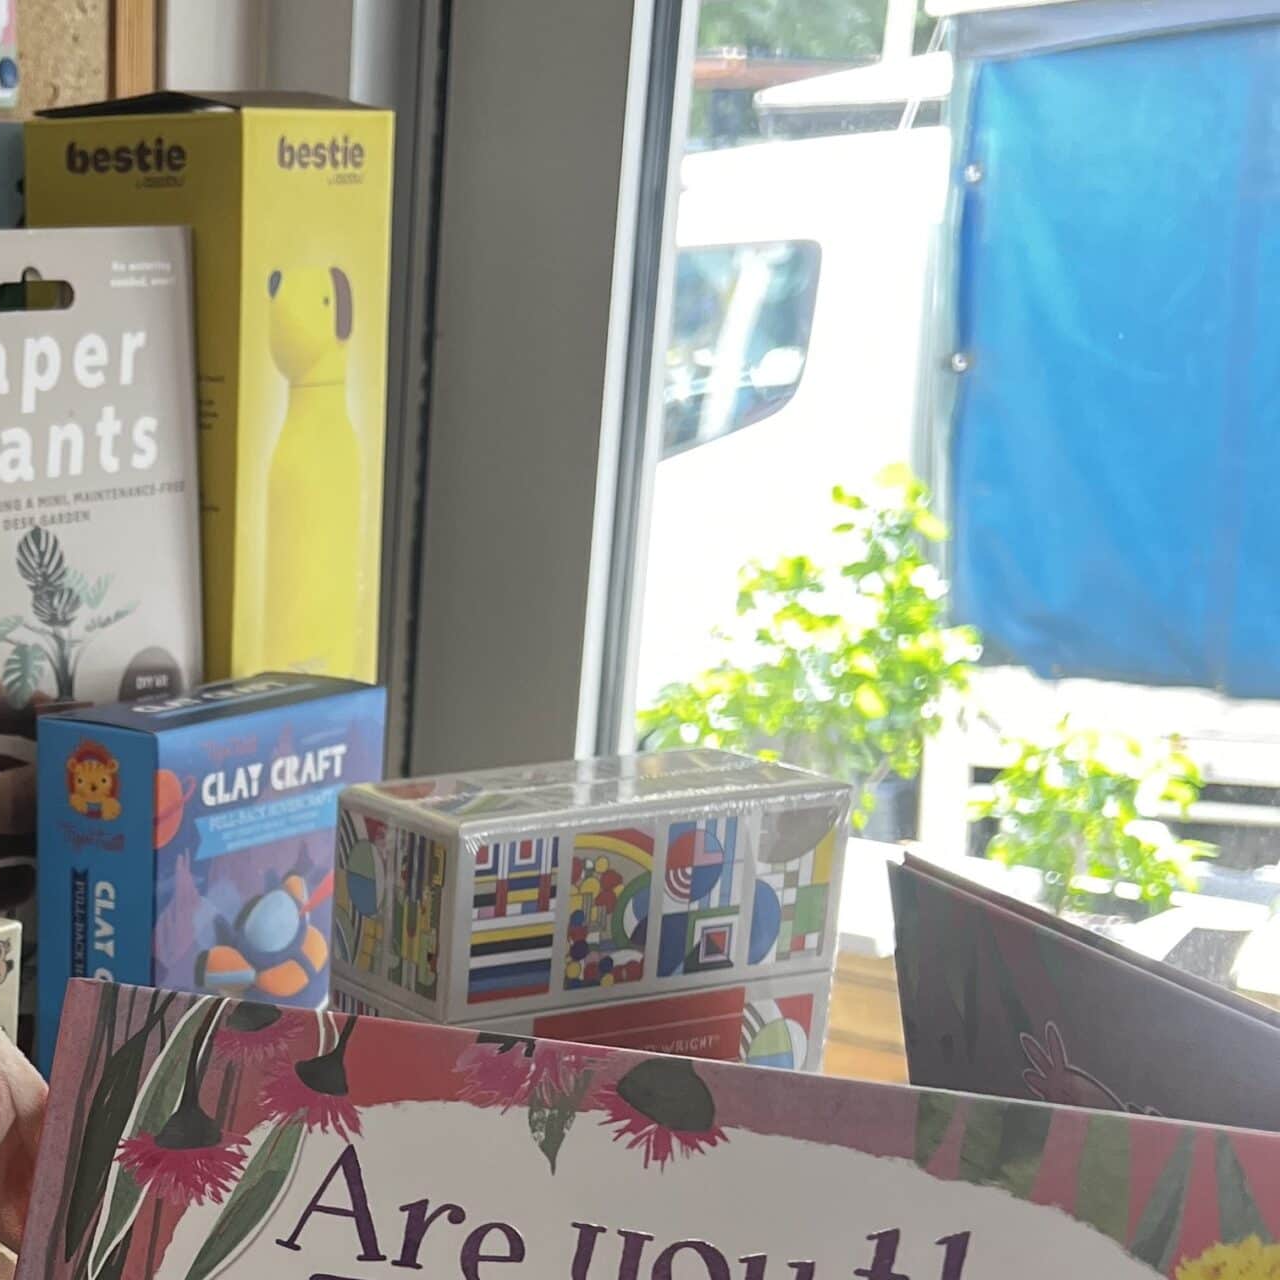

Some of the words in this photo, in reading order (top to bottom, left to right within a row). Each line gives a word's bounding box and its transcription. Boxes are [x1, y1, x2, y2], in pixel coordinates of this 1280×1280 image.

[65, 136, 187, 175] bestie
[277, 135, 365, 170] bestie
[24, 498, 35, 511] A
[38, 509, 91, 528] GARDEN
[201, 762, 264, 807] CLAY
[270, 743, 348, 791] CRAFT
[93, 880, 116, 959] CLAY
